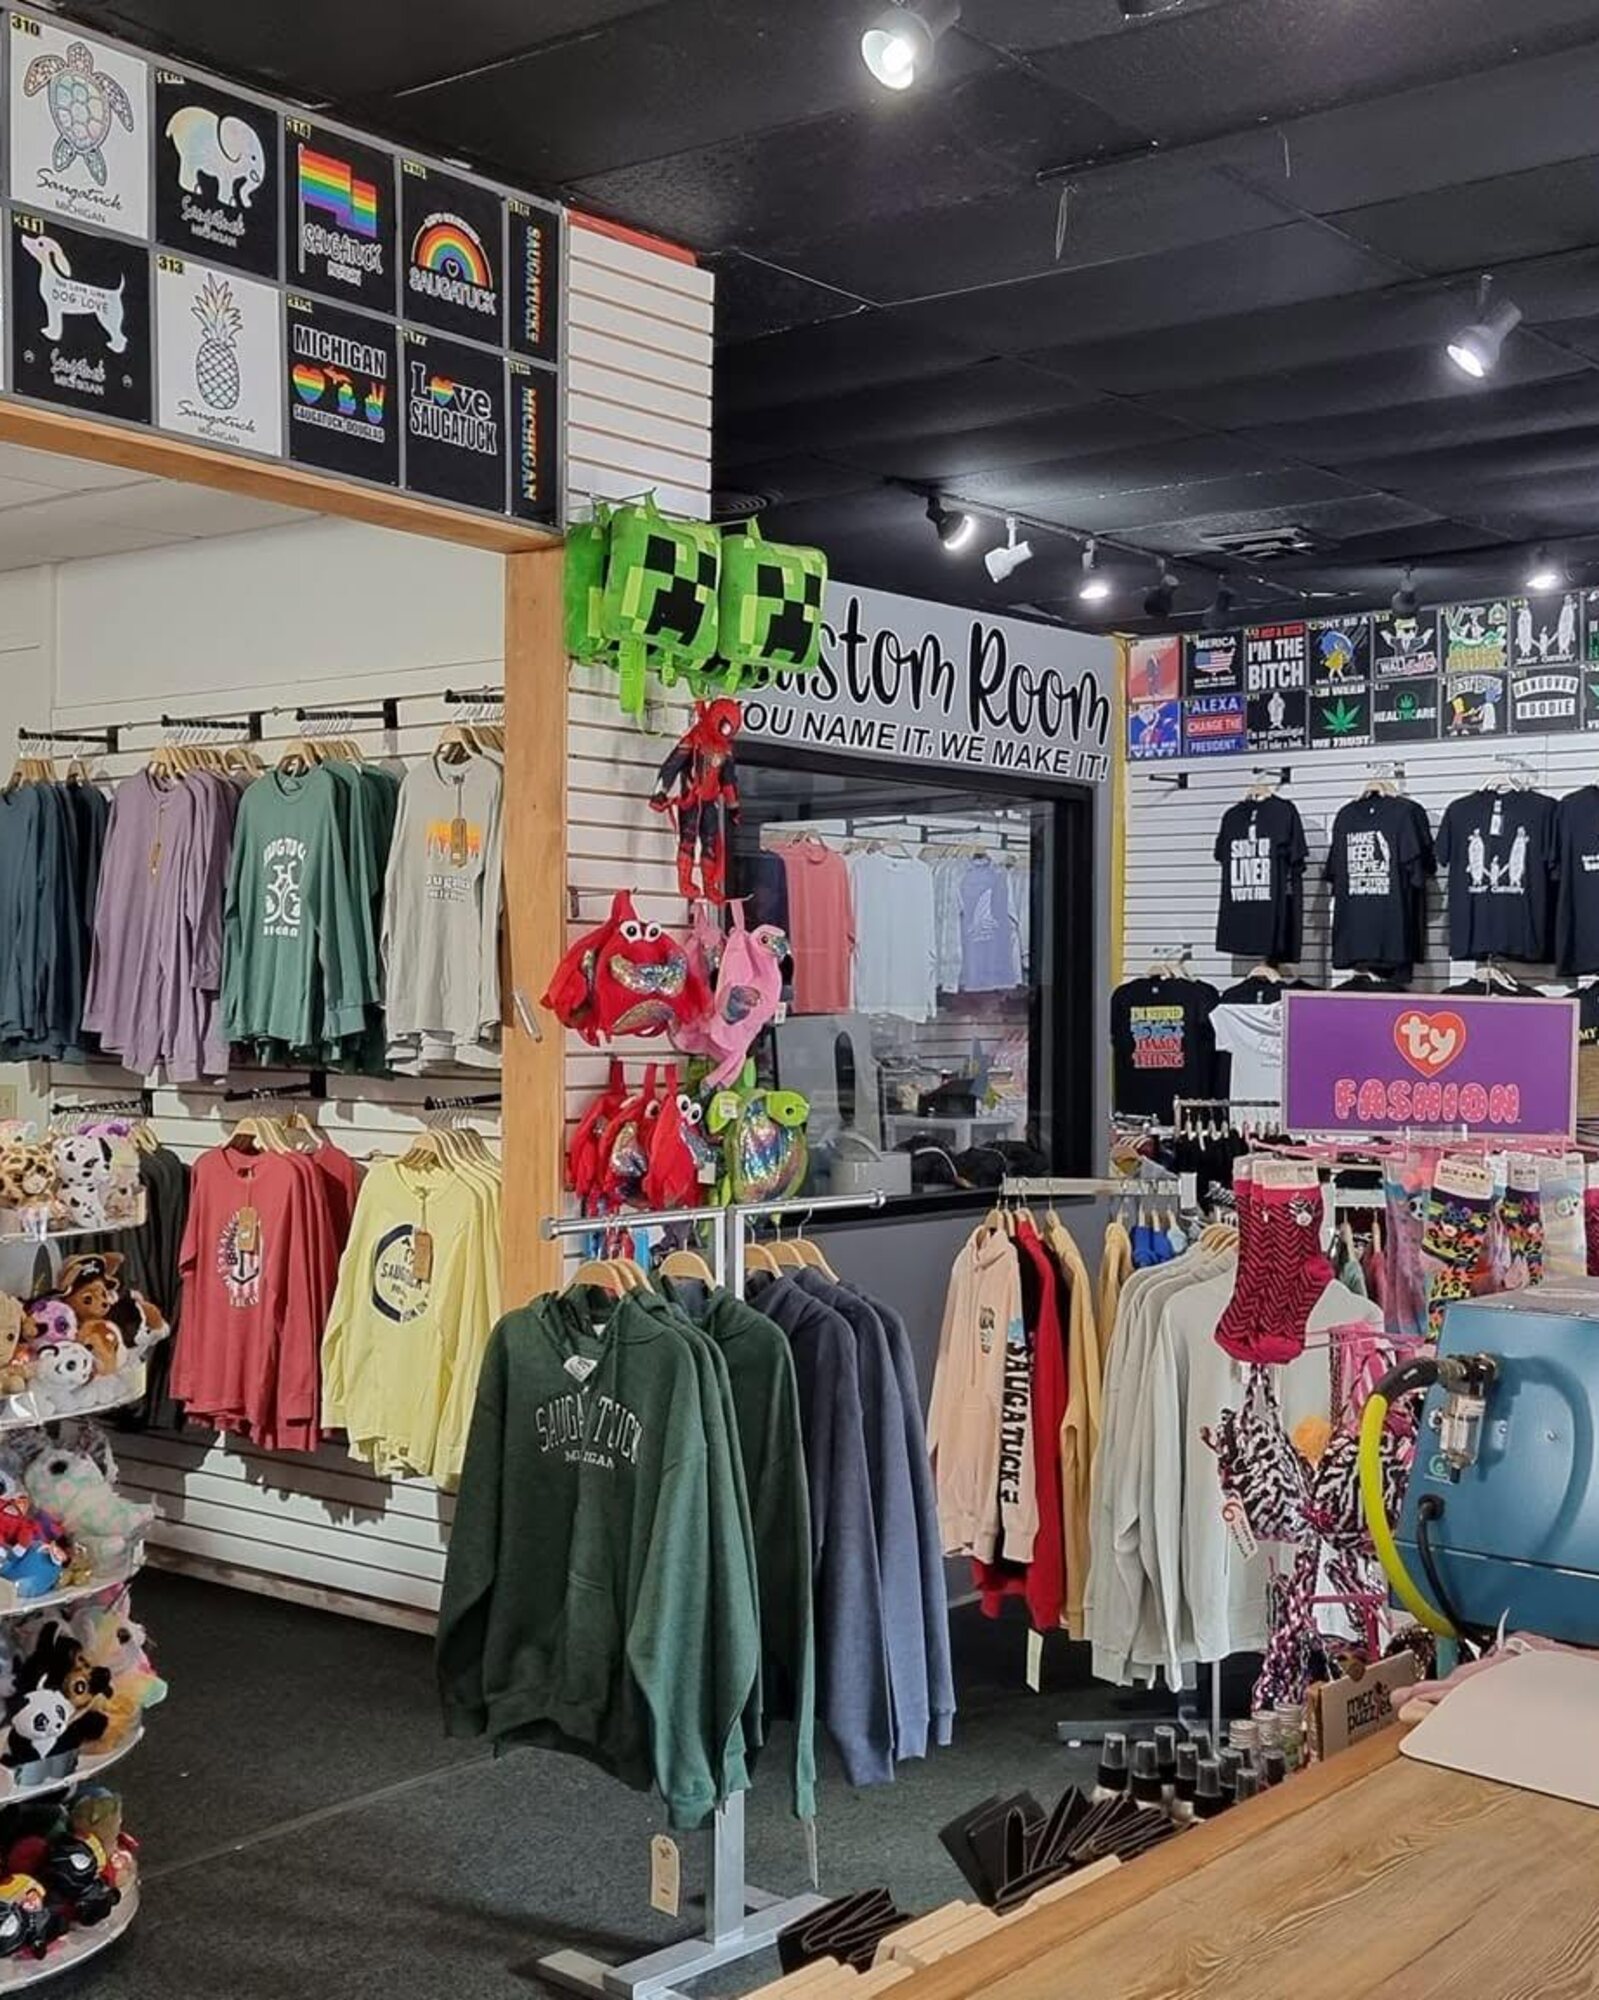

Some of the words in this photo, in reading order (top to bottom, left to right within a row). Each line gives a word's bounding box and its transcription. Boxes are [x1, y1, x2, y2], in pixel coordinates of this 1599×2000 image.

[11, 15, 40, 36] 310
[158, 257, 184, 273] 313
[303, 223, 384, 275] SAUGATUCK
[409, 265, 497, 315] SAUGATUCK
[293, 323, 387, 380] MICHIGAN
[410, 400, 498, 456] SAUGATUCK
[520, 386, 538, 501] MICHIGAN
[750, 597, 956, 716] stom
[968, 621, 1111, 746] Room
[1248, 640, 1271, 663] I'M
[1274, 637, 1304, 660] THE
[1248, 660, 1304, 692] BITCH
[1192, 697, 1239, 714] ALEXA
[738, 700, 796, 737] OU
[801, 712, 897, 751] NAME
[902, 726, 933, 757] IT,
[940, 731, 987, 764] WE
[991, 740, 1071, 776] MAKE
[1076, 753, 1109, 780] IT!
[1401, 1015, 1456, 1065] ty
[1334, 1078, 1520, 1124] FASHION
[1000, 1341, 1031, 1487] SAUGATUCK
